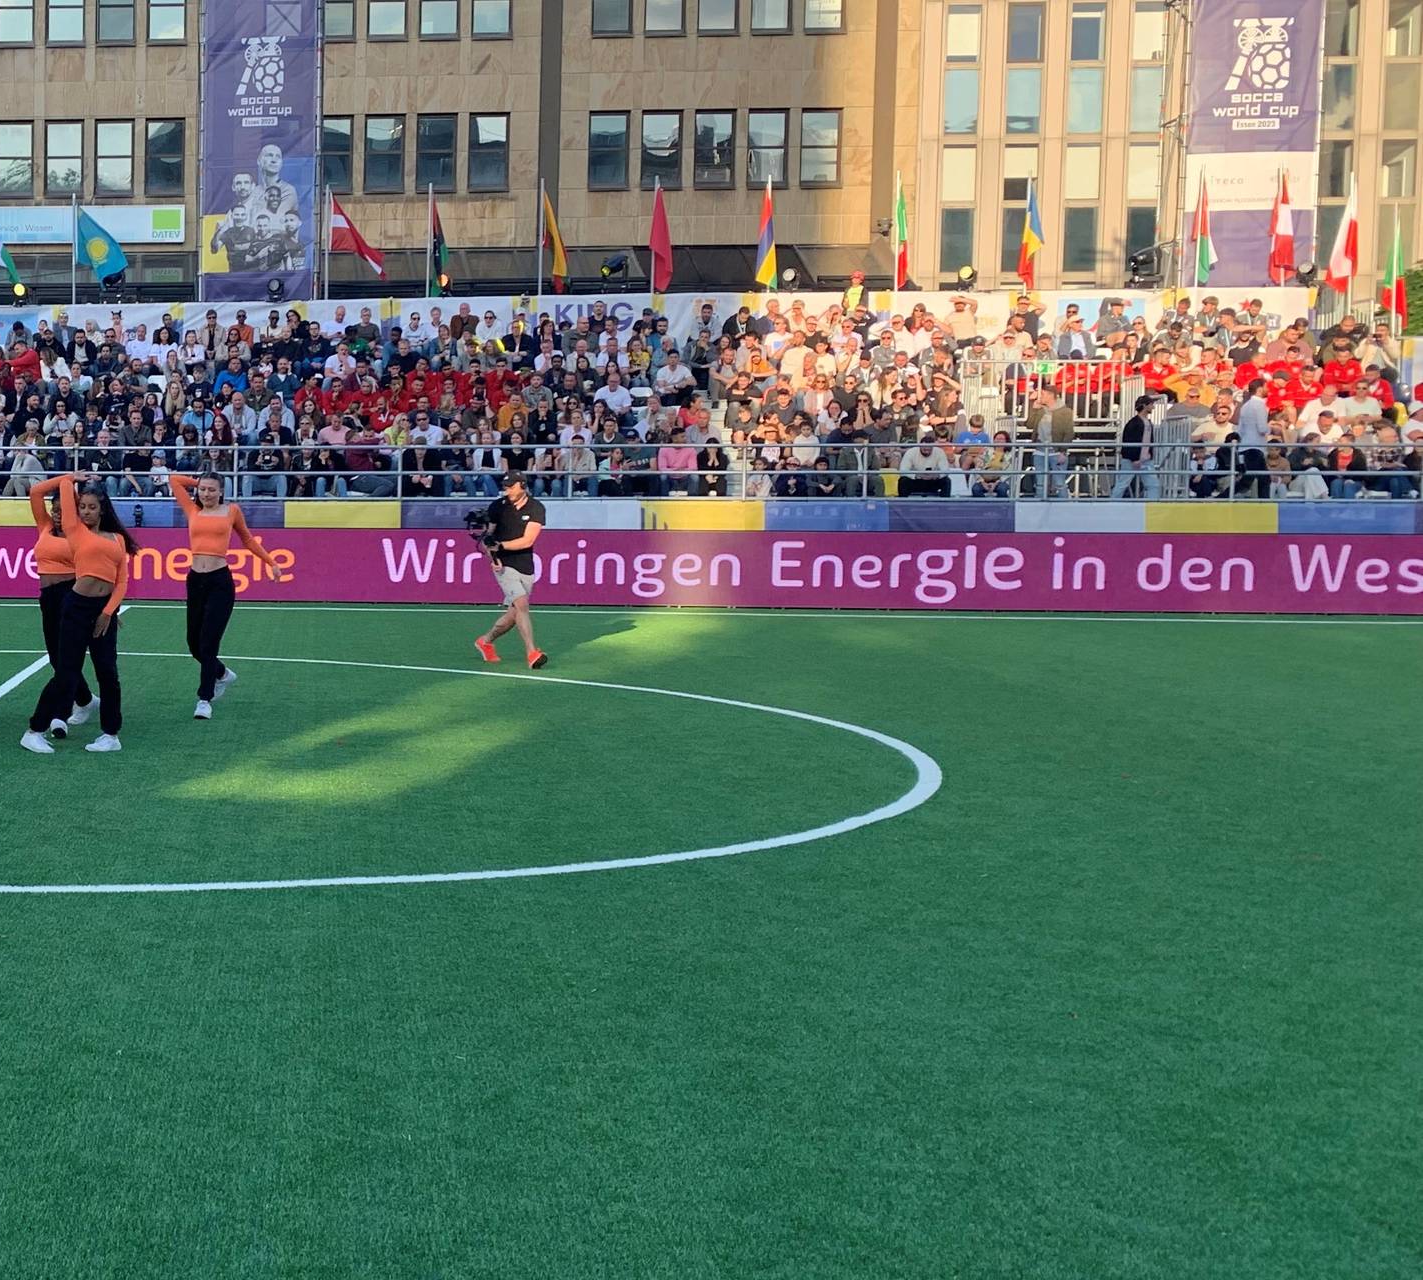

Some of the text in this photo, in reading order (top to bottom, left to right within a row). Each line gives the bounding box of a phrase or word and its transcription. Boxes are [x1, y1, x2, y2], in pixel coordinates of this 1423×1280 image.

[241, 96, 280, 105] socca
[1230, 92, 1284, 103] socca
[227, 105, 292, 117] world cup
[1212, 104, 1299, 118] world cup
[152, 231, 181, 239] DATEV
[382, 538, 483, 584] Wir
[771, 532, 1024, 604] Energie
[1052, 537, 1106, 590] in
[1137, 543, 1254, 592] den
